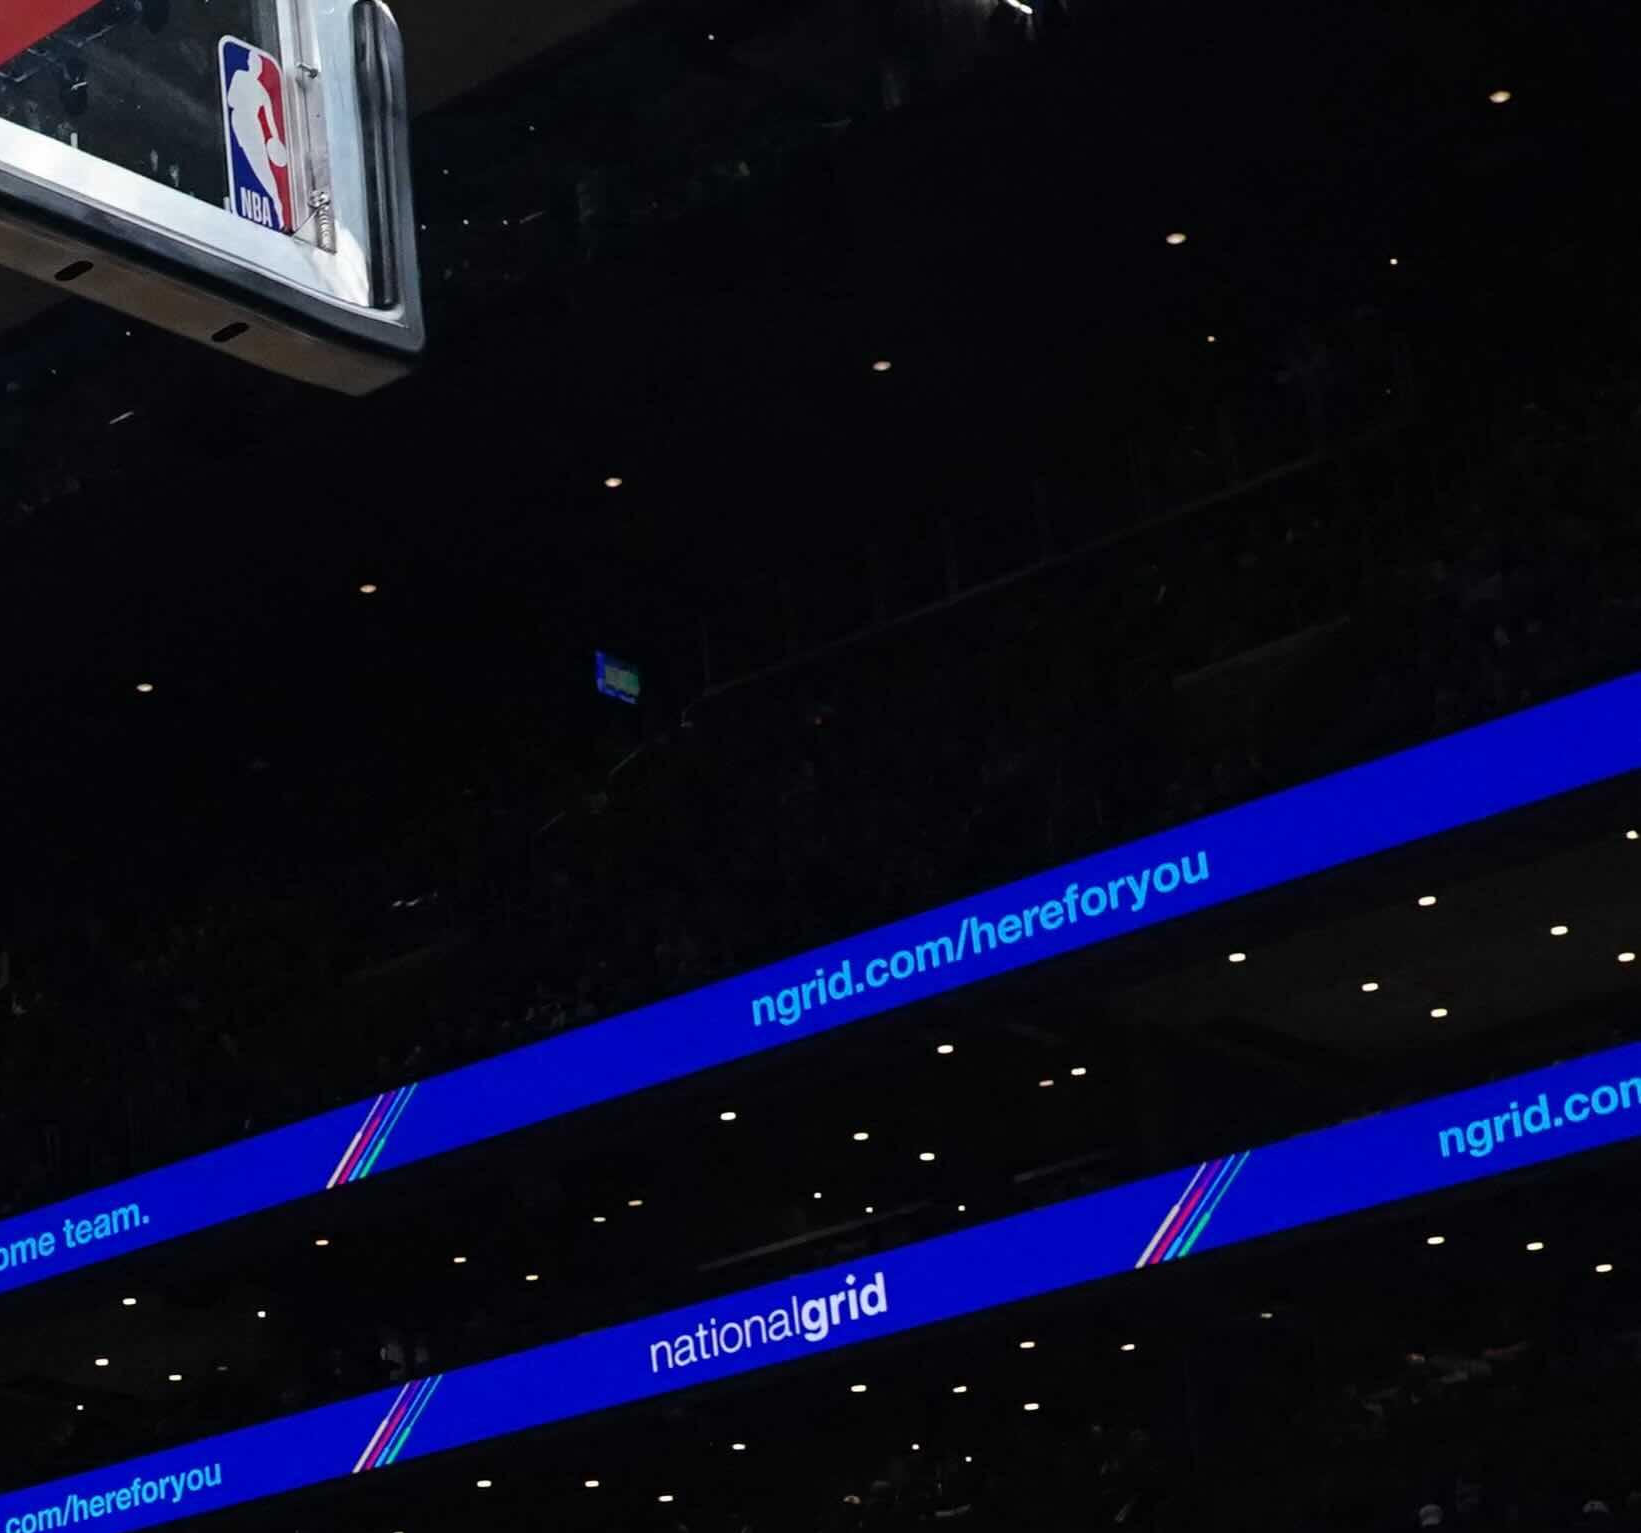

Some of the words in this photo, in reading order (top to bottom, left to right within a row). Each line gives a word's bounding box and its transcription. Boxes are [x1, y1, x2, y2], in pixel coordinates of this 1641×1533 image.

[240, 187, 272, 228] NBA
[751, 850, 1210, 1026] ngrid.com/hereforyou
[62, 1201, 150, 1250] team.
[650, 1271, 888, 1374] nationalgrid
